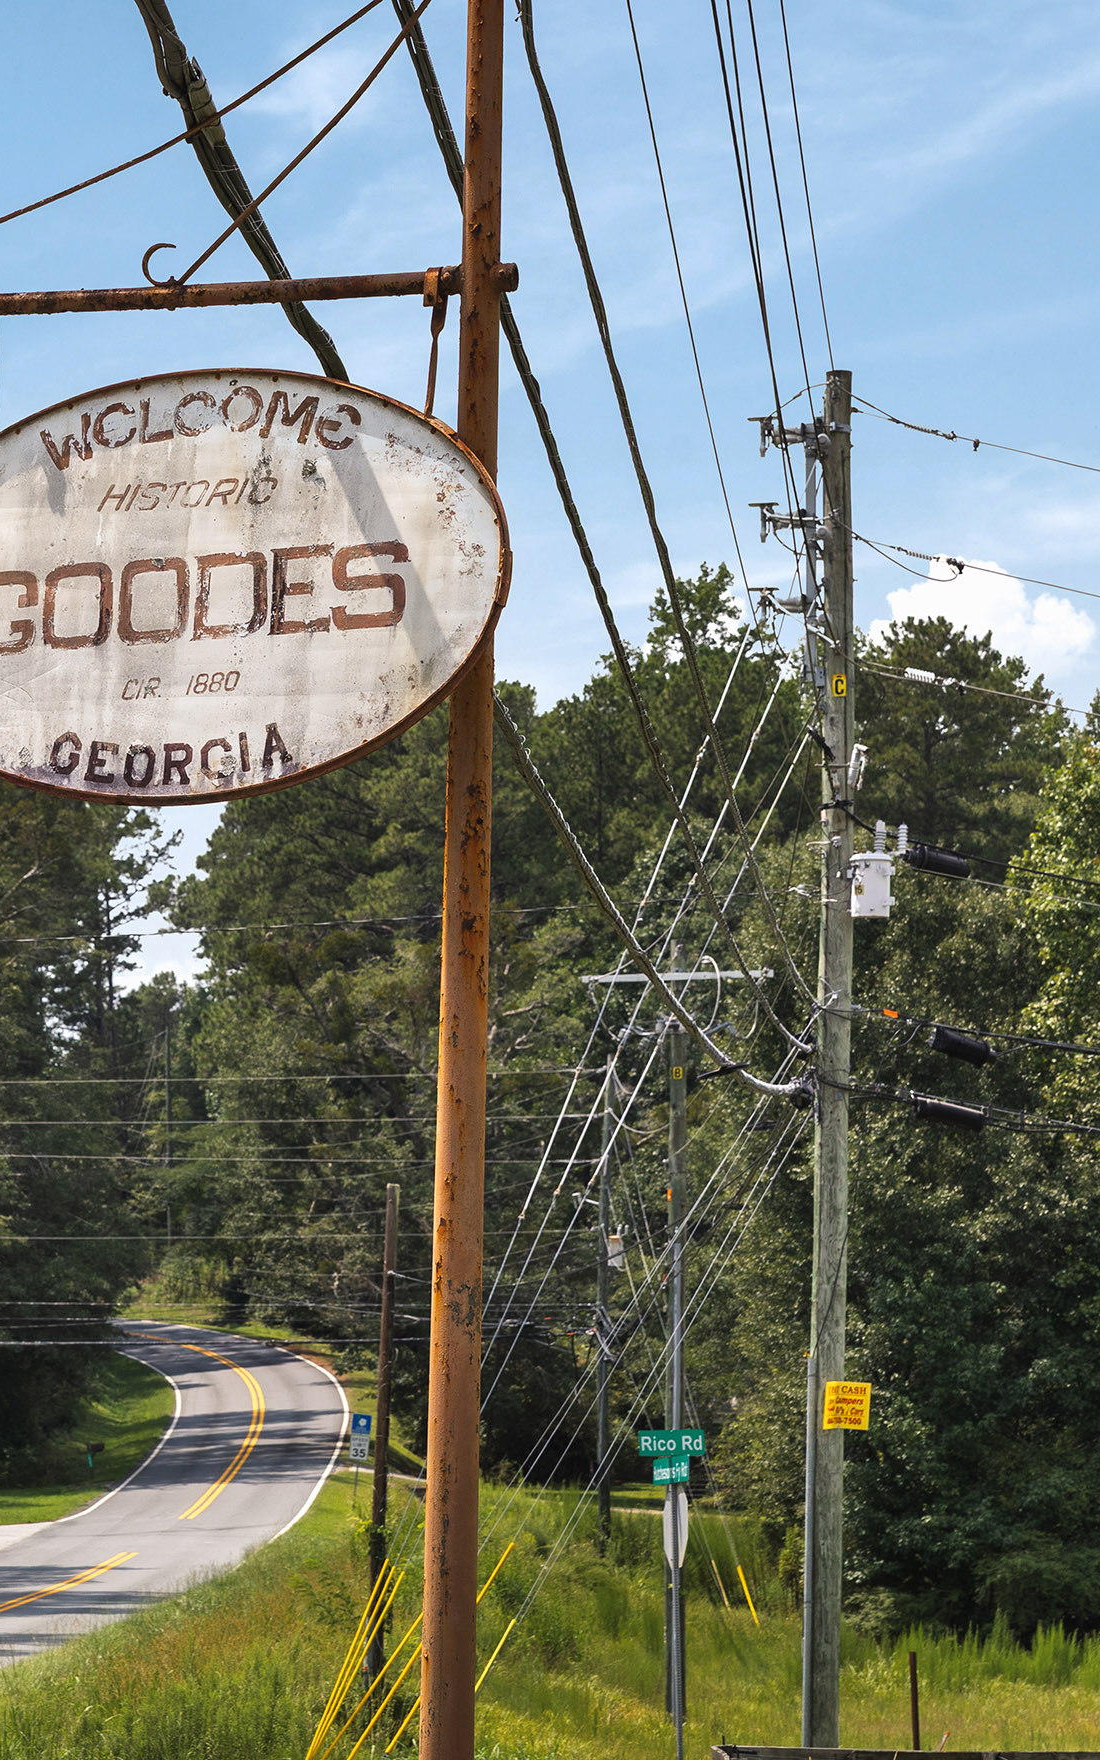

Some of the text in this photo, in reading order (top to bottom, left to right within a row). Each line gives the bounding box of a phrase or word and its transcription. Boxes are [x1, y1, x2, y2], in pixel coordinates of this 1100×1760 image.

[40, 385, 362, 471] WELCOME
[97, 476, 278, 512] HISTORIC
[185, 670, 241, 696] 1880
[835, 678, 844, 695] C
[49, 722, 293, 789] GEORGIA
[841, 1385, 867, 1395] CASH
[352, 1448, 366, 1458] 35
[641, 1435, 703, 1452] Rico Rd
